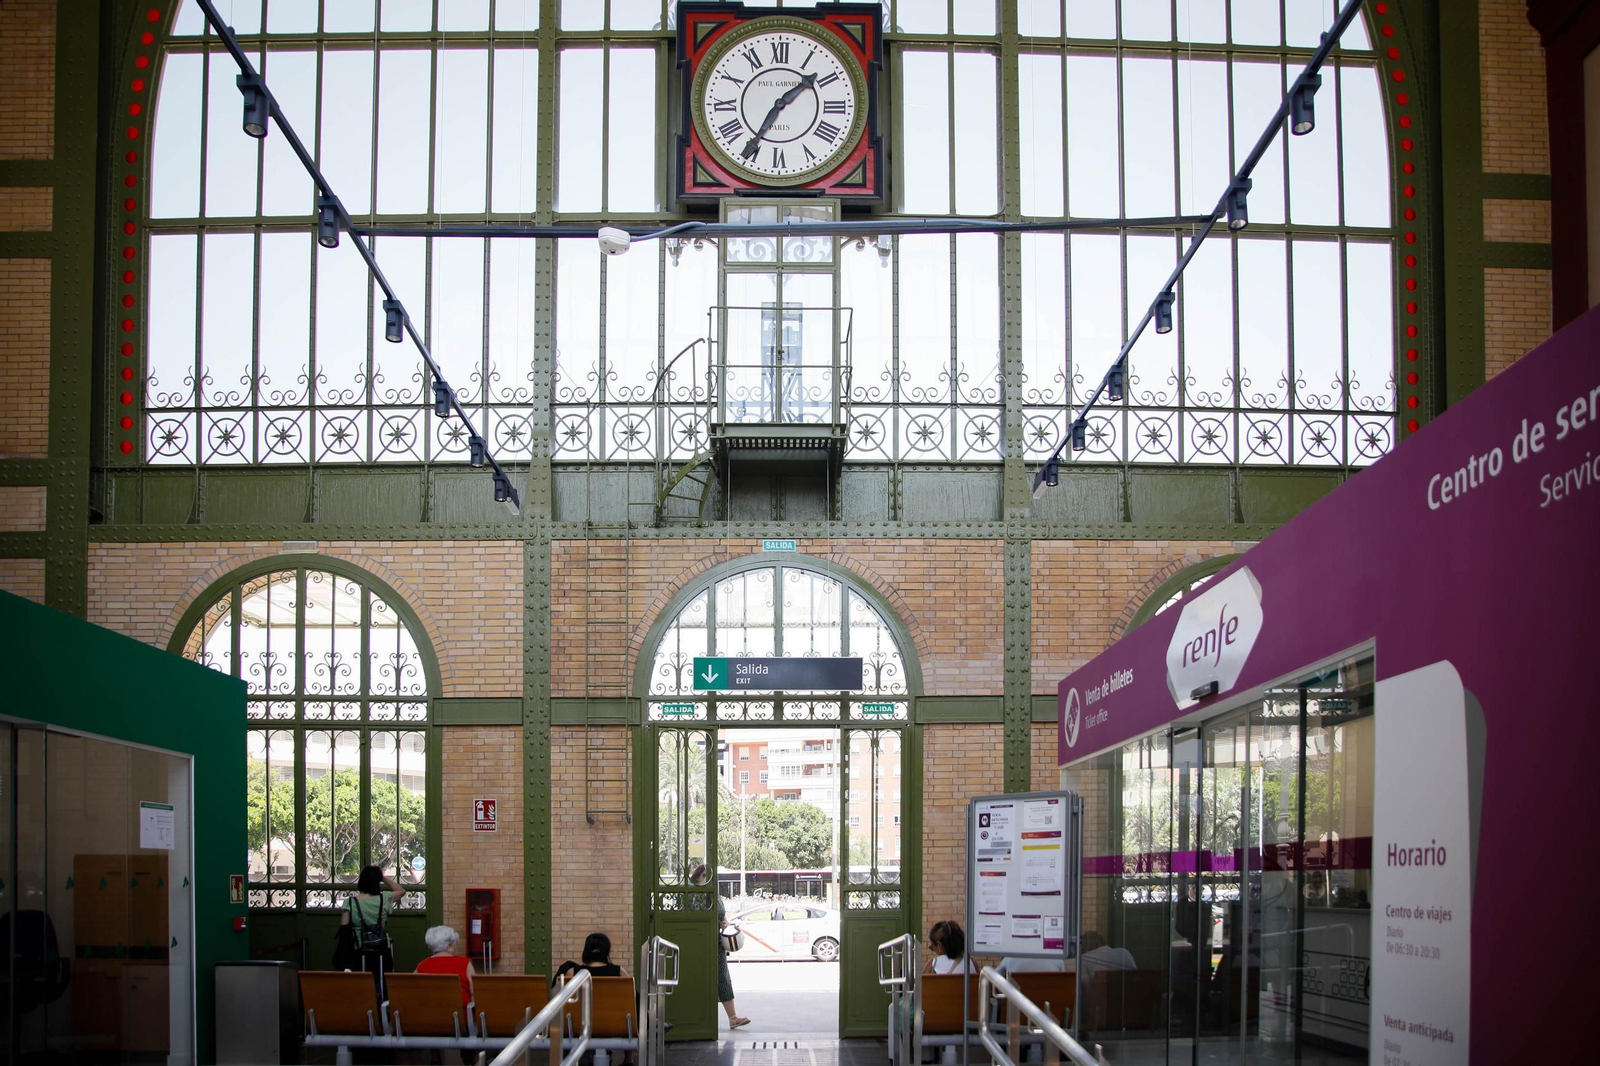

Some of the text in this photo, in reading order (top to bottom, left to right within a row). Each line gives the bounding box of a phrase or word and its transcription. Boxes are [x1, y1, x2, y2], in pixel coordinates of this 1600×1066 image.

[741, 47, 764, 73] XI
[770, 42, 790, 64] XII
[720, 70, 744, 89] X
[823, 100, 846, 115] III
[1427, 385, 1600, 511] Centro de ser
[765, 541, 793, 549] SALIDA
[1182, 603, 1239, 669] renfe
[736, 663, 769, 675] Salida
[1085, 668, 1134, 706] Venta de billetes
[1085, 709, 1108, 730] Ticket office
[1387, 839, 1447, 867] Horario
[1386, 904, 1452, 924] Centro de viajes
[1386, 925, 1403, 938] Diario
[1386, 941, 1393, 953] De
[1415, 947, 1419, 957] a
[1421, 945, 1440, 960] 20:30
[1383, 1014, 1454, 1043] Venta anticipada
[1384, 1038, 1401, 1053] Diario
